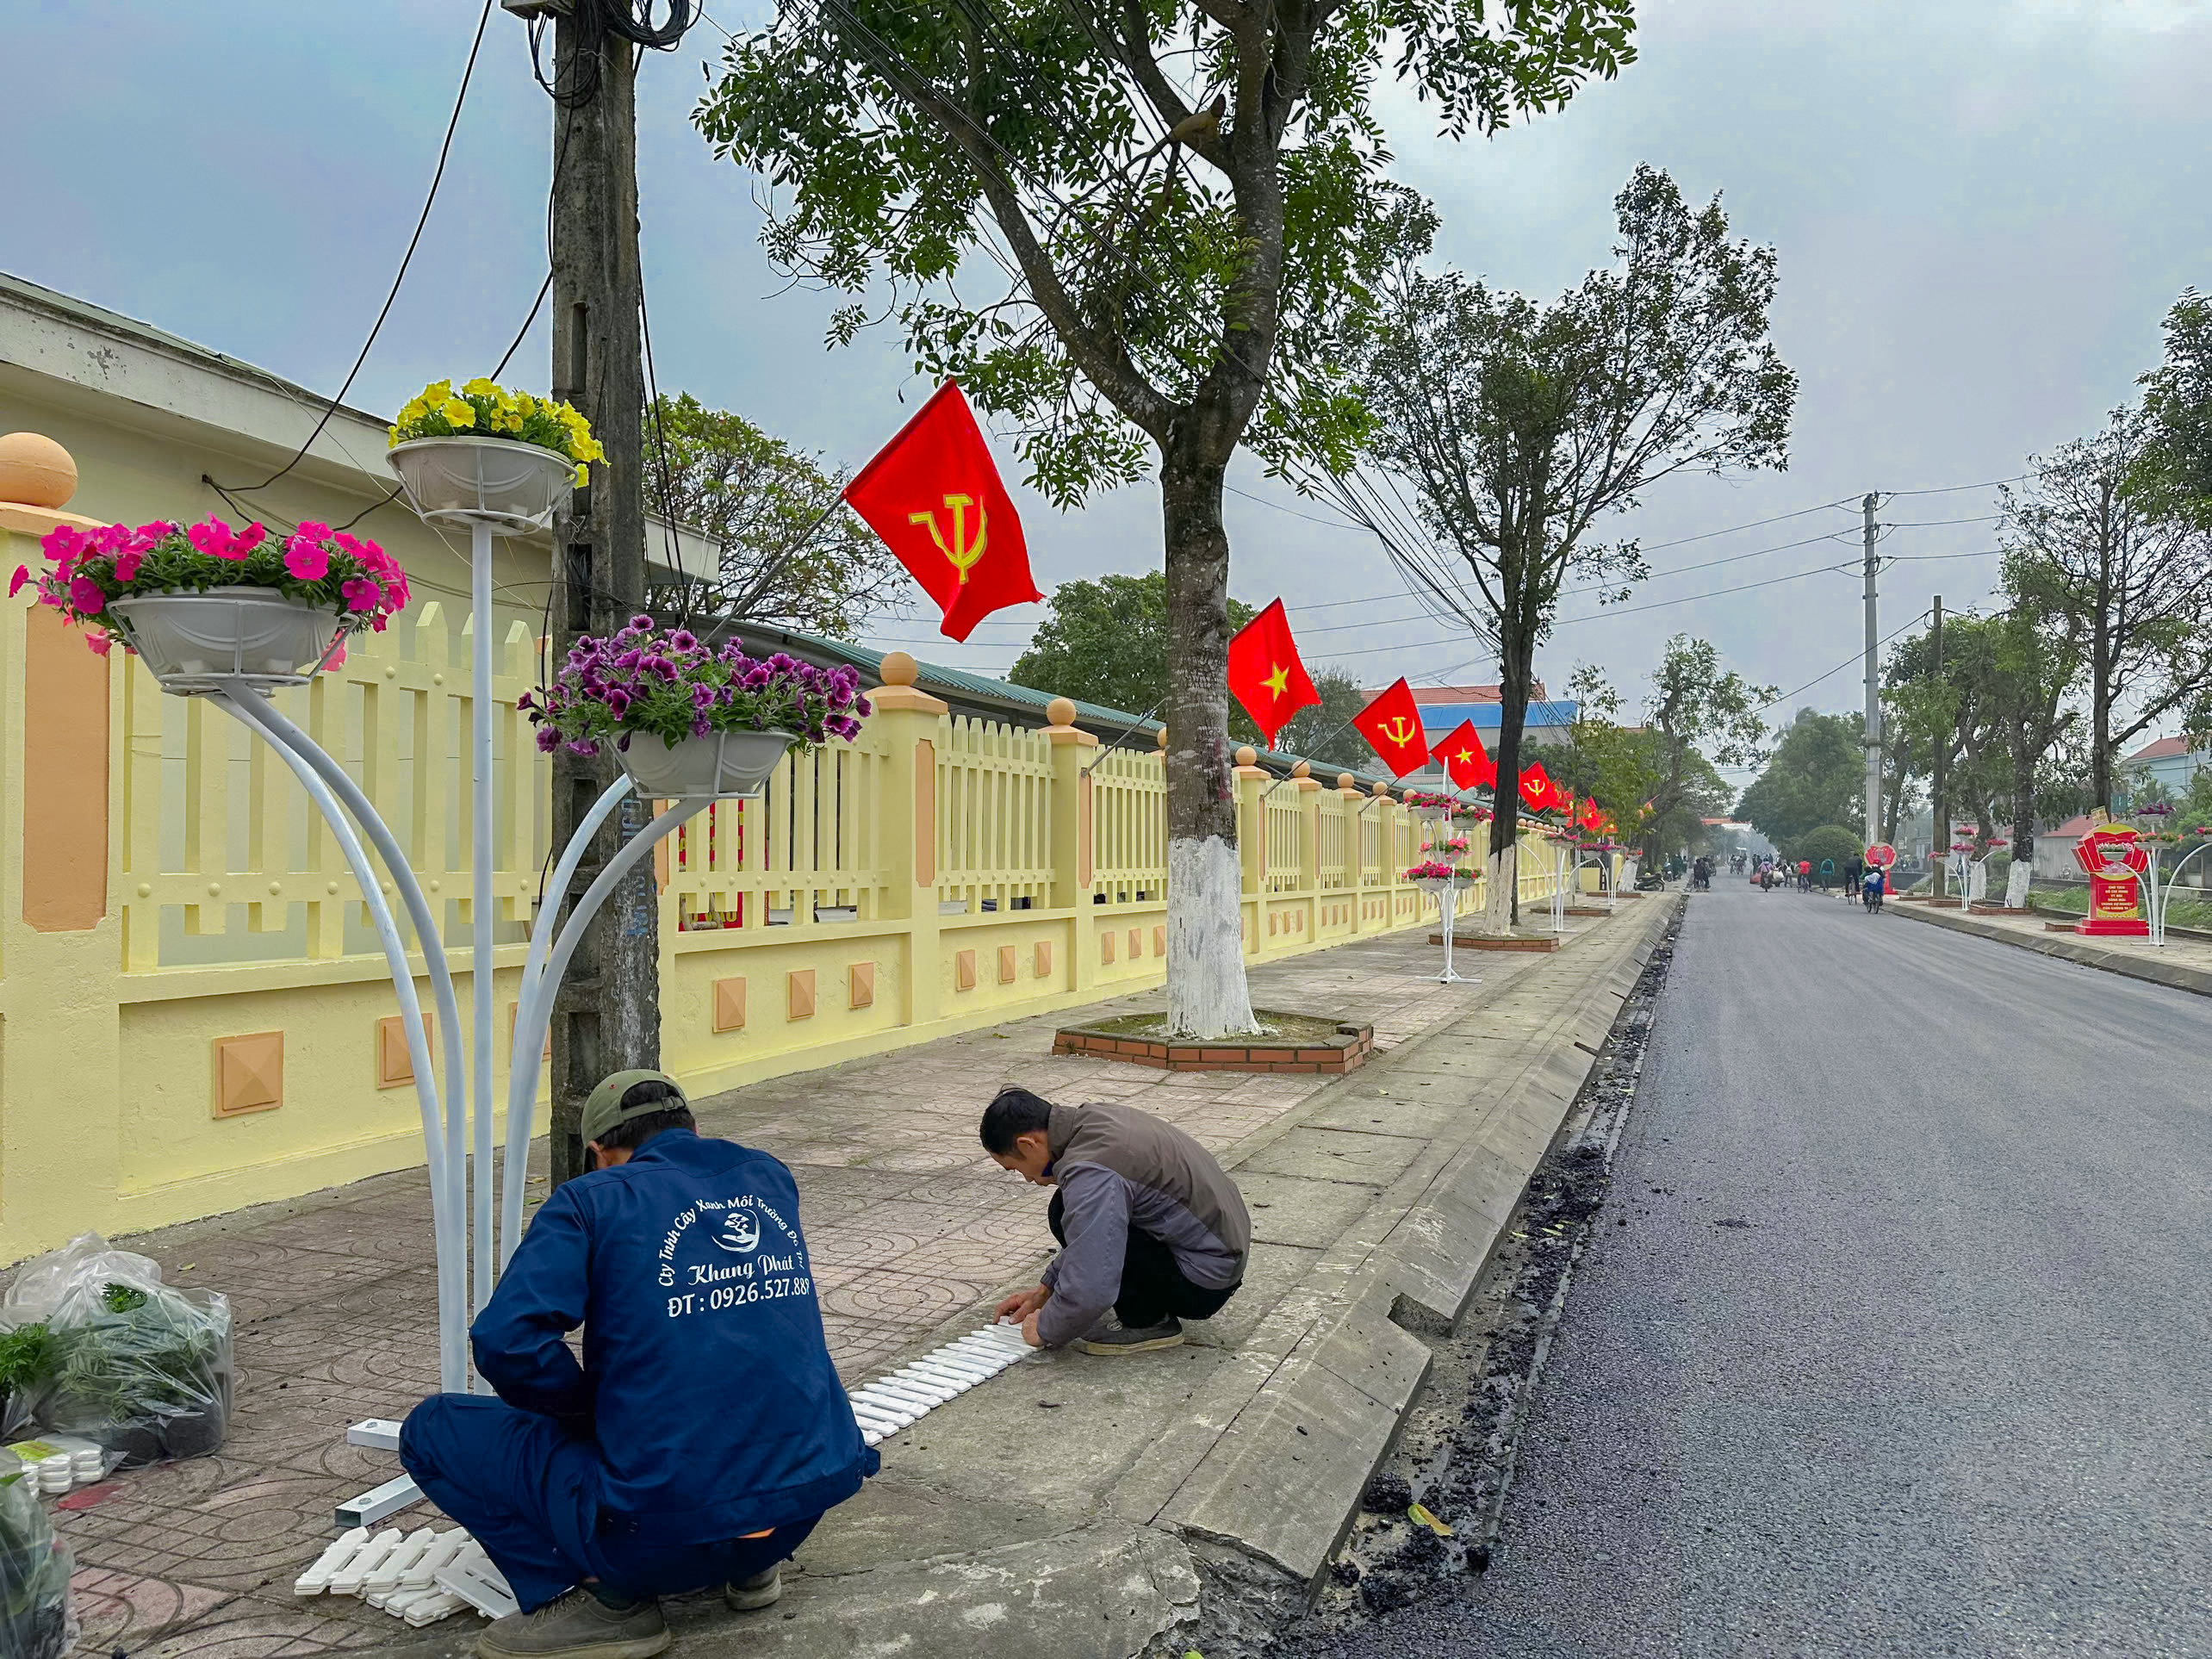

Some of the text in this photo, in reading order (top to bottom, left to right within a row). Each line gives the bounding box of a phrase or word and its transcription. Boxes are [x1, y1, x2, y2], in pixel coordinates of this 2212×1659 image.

[695, 1199, 725, 1212] Xanh
[727, 1195, 754, 1209] Môi
[756, 1196, 787, 1231] Trường
[674, 1209, 696, 1230] Cây
[659, 1230, 680, 1260] Tnhh
[658, 1264, 675, 1287] Cty
[687, 1254, 795, 1285] Khang Phát
